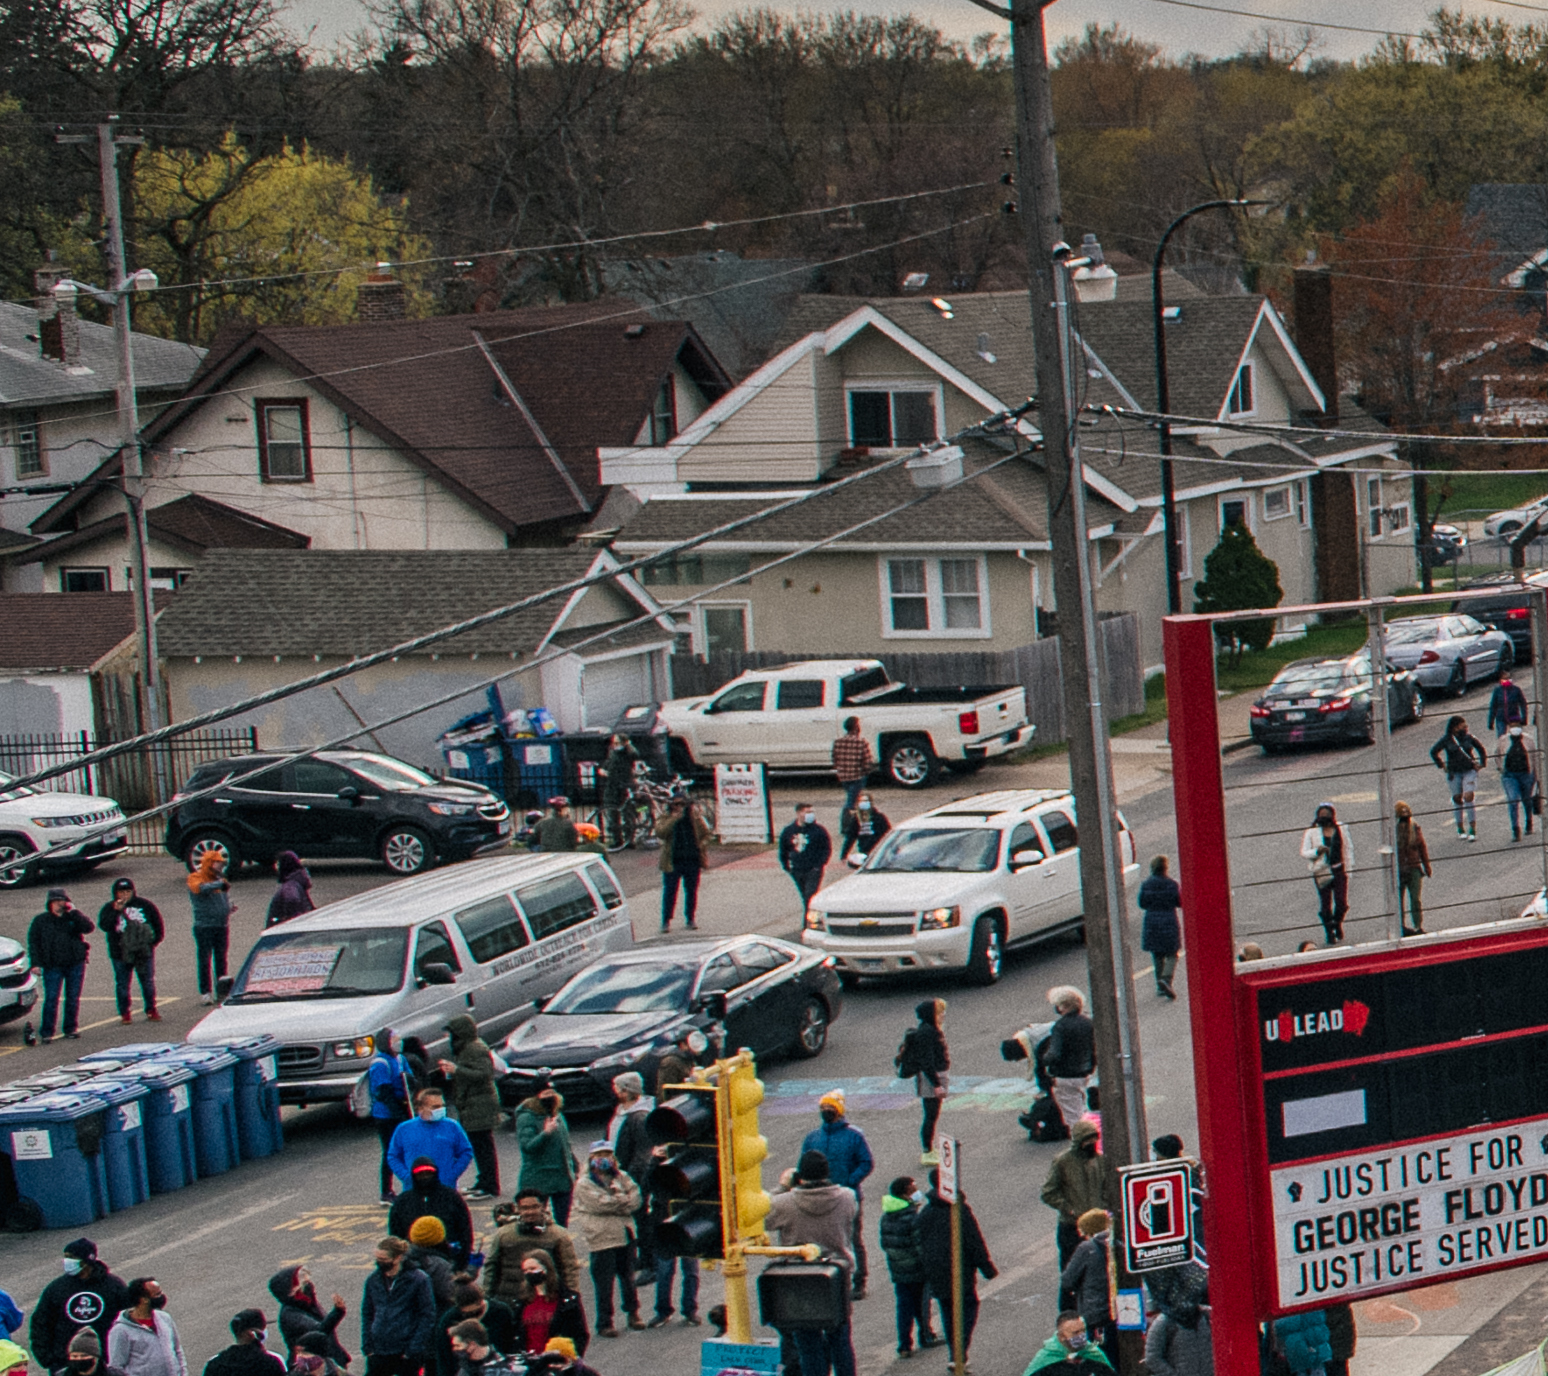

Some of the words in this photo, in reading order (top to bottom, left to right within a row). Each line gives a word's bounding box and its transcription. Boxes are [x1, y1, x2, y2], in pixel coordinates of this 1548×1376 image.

[1317, 1146, 1453, 1203] JUSTICE
[1470, 1134, 1524, 1174] FOR
[1137, 1245, 1185, 1259] Fuelman
[1294, 1201, 1422, 1254] GEORGE
[1295, 1239, 1427, 1297] JUSTICE
